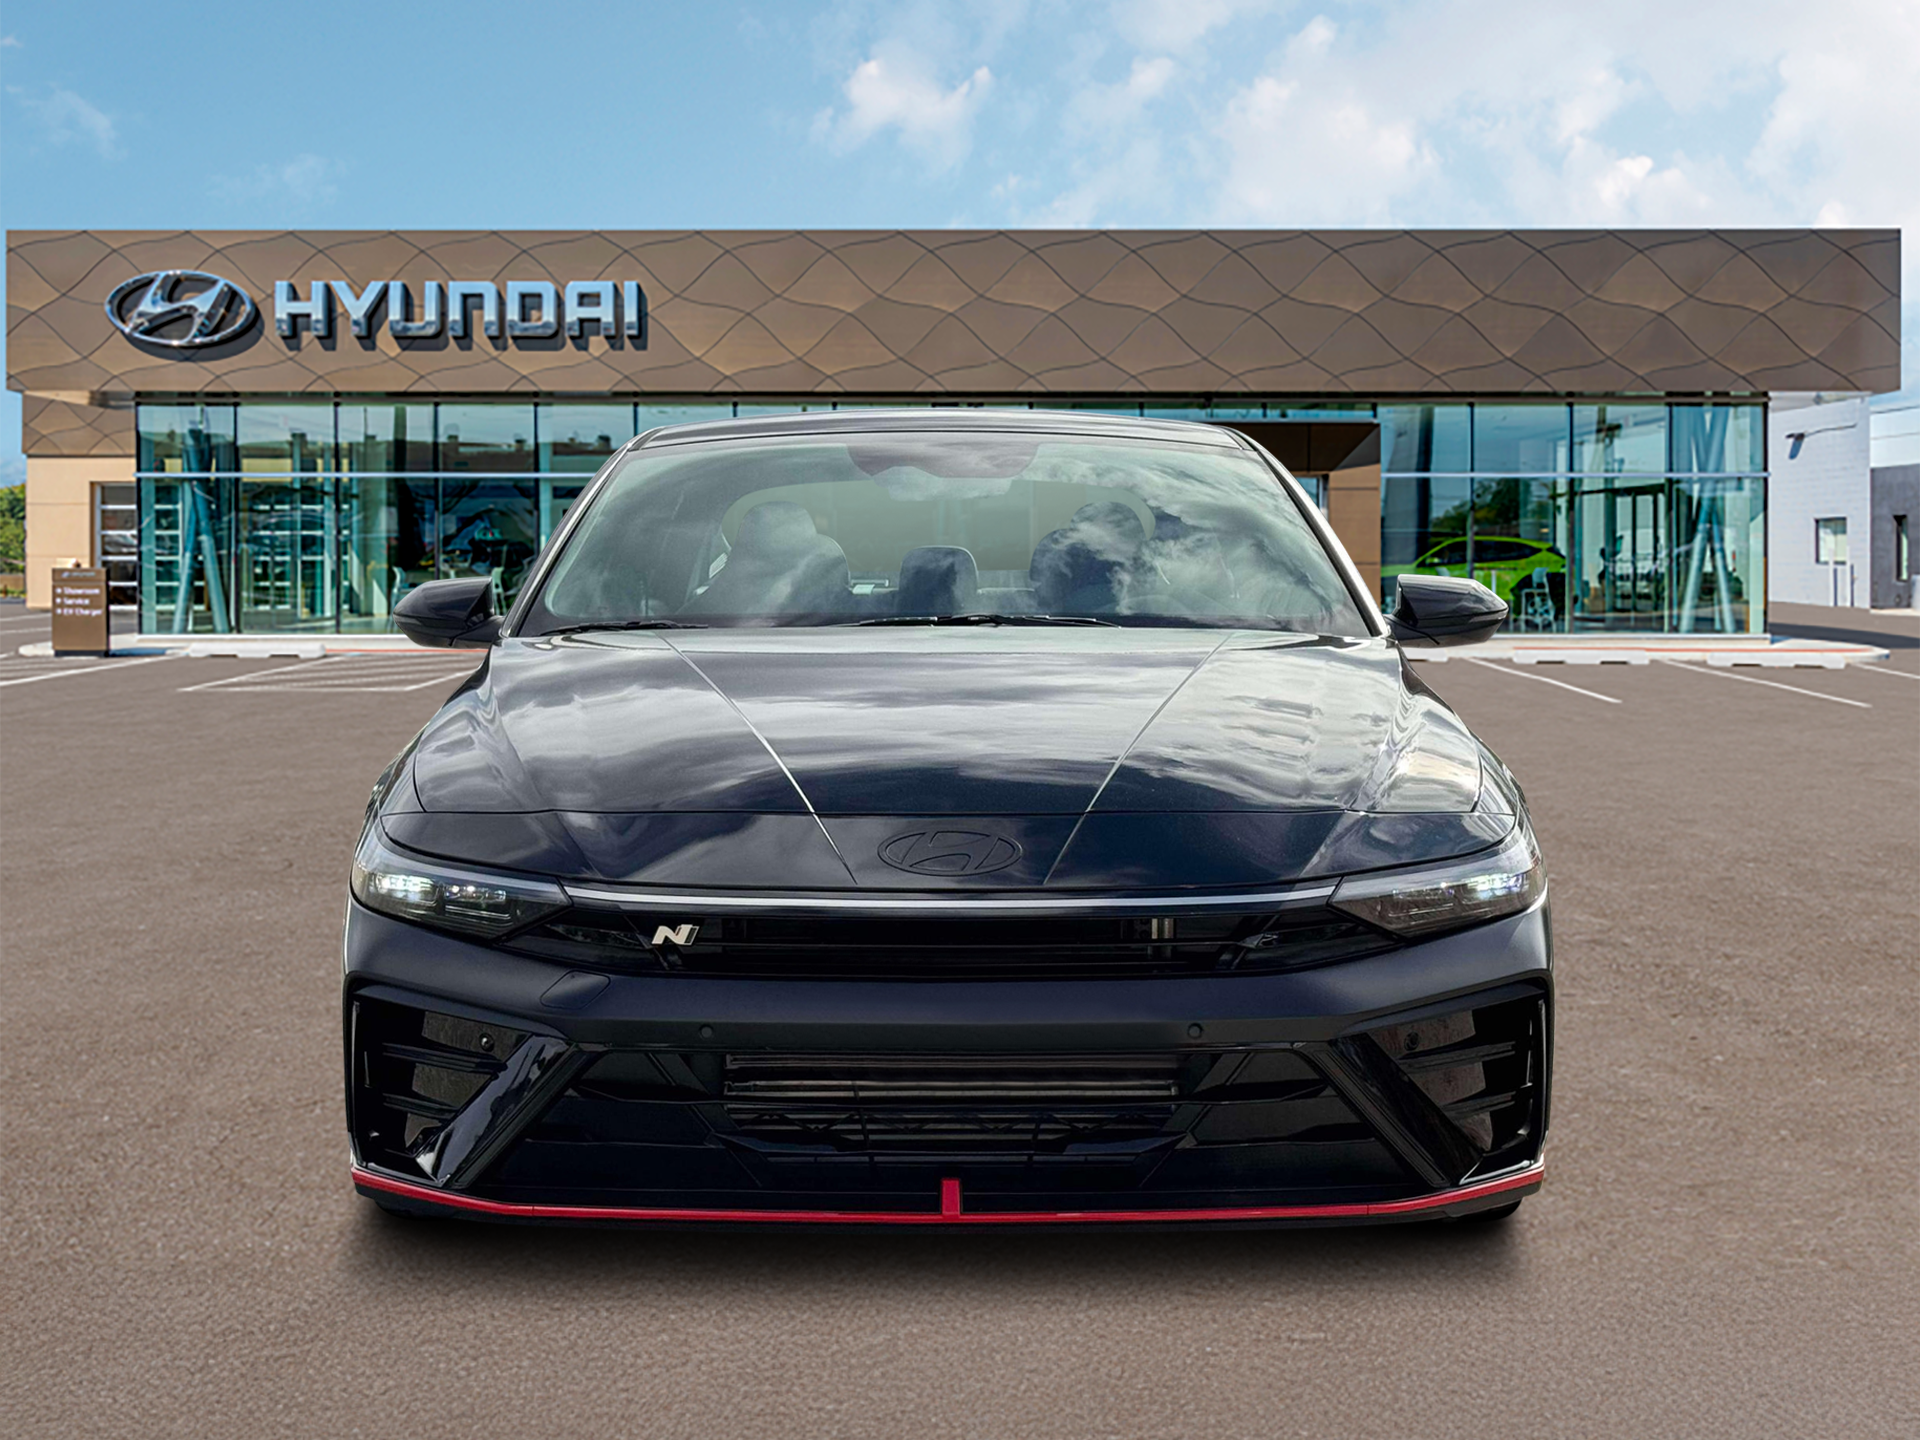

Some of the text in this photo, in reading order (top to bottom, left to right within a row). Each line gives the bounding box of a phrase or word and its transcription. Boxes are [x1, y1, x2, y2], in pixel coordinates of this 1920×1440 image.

[274, 280, 641, 338] HYUNDAI
[63, 587, 100, 595] Showroom
[63, 597, 90, 605] Service
[75, 608, 103, 617] Charger
